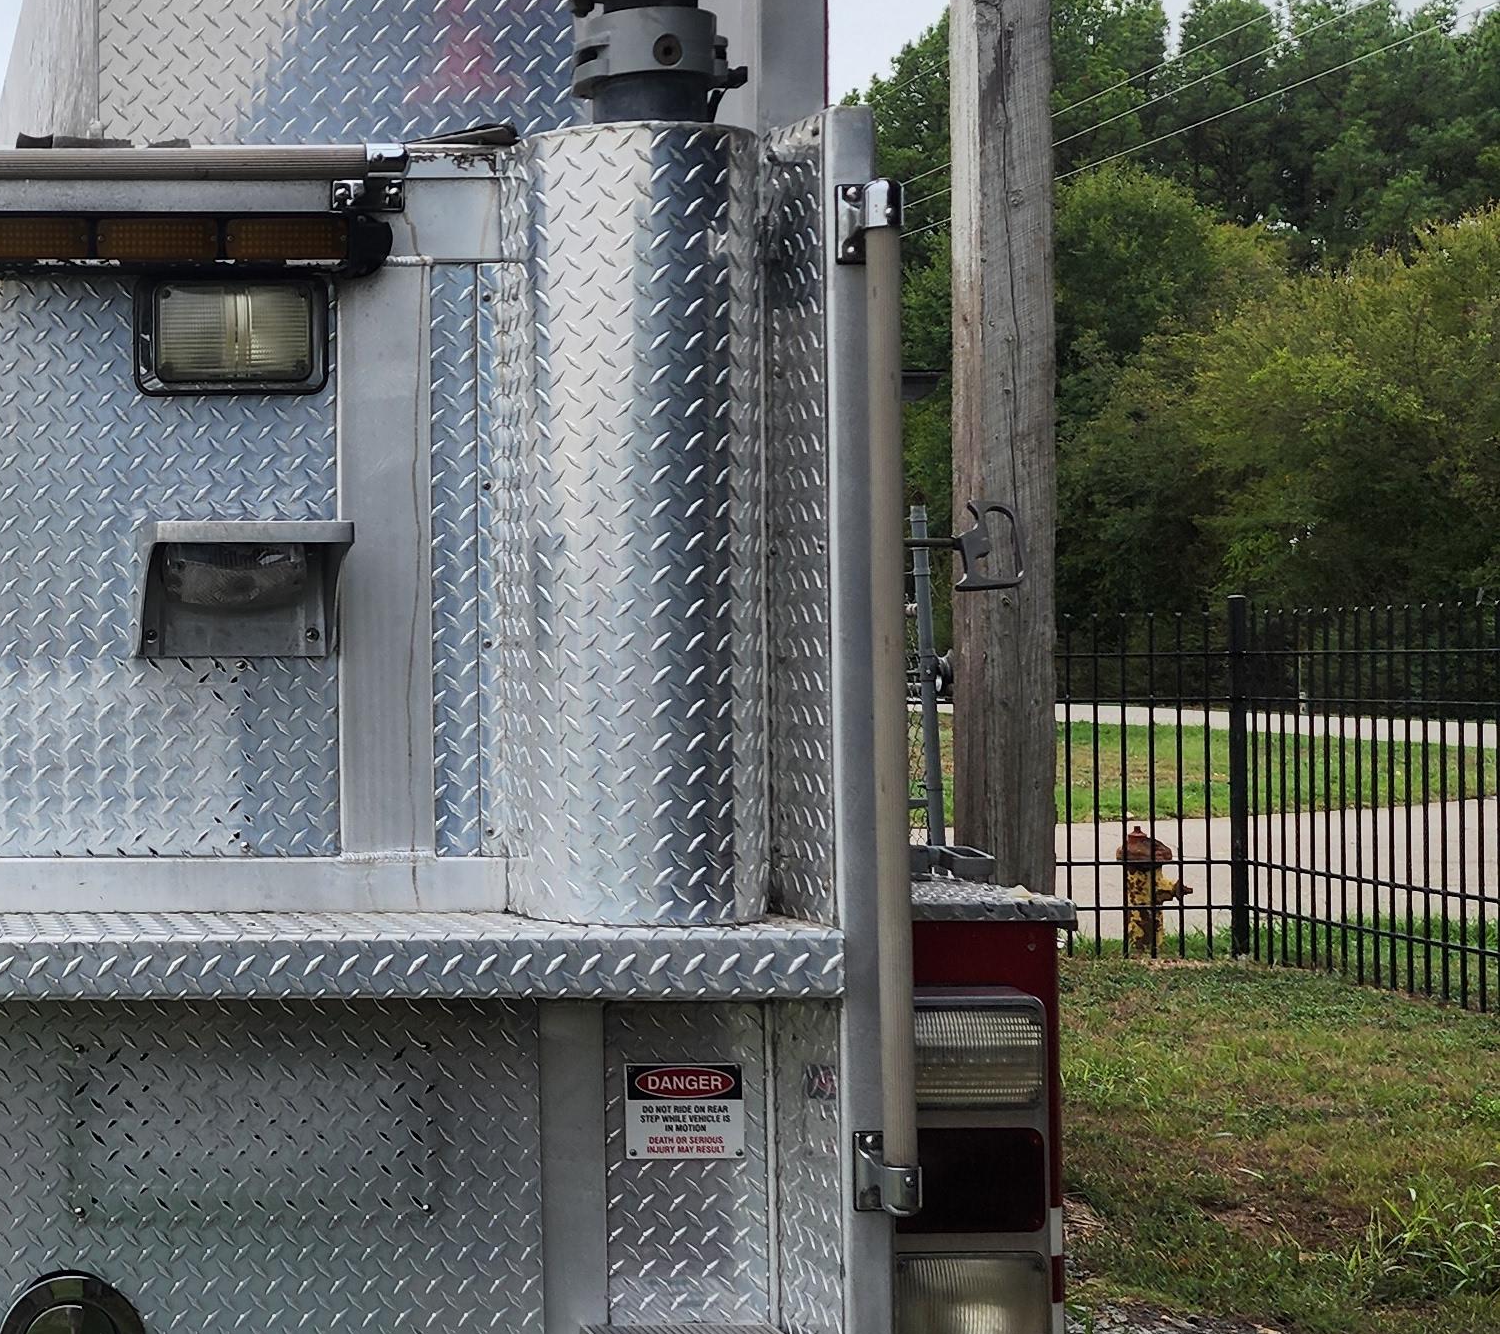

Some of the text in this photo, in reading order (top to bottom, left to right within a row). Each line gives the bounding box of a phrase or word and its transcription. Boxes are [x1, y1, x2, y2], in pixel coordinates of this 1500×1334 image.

[647, 1076, 723, 1090] DANGER
[642, 1105, 728, 1114] DO NOT RIDE ON REAR
[640, 1115, 731, 1123] STEP WHILE VEHICLE IS
[665, 1124, 707, 1132] IN MOTION
[648, 1136, 724, 1145] DEATH OR SERIOUS
[646, 1146, 725, 1154] INJURY MAY RESULT
